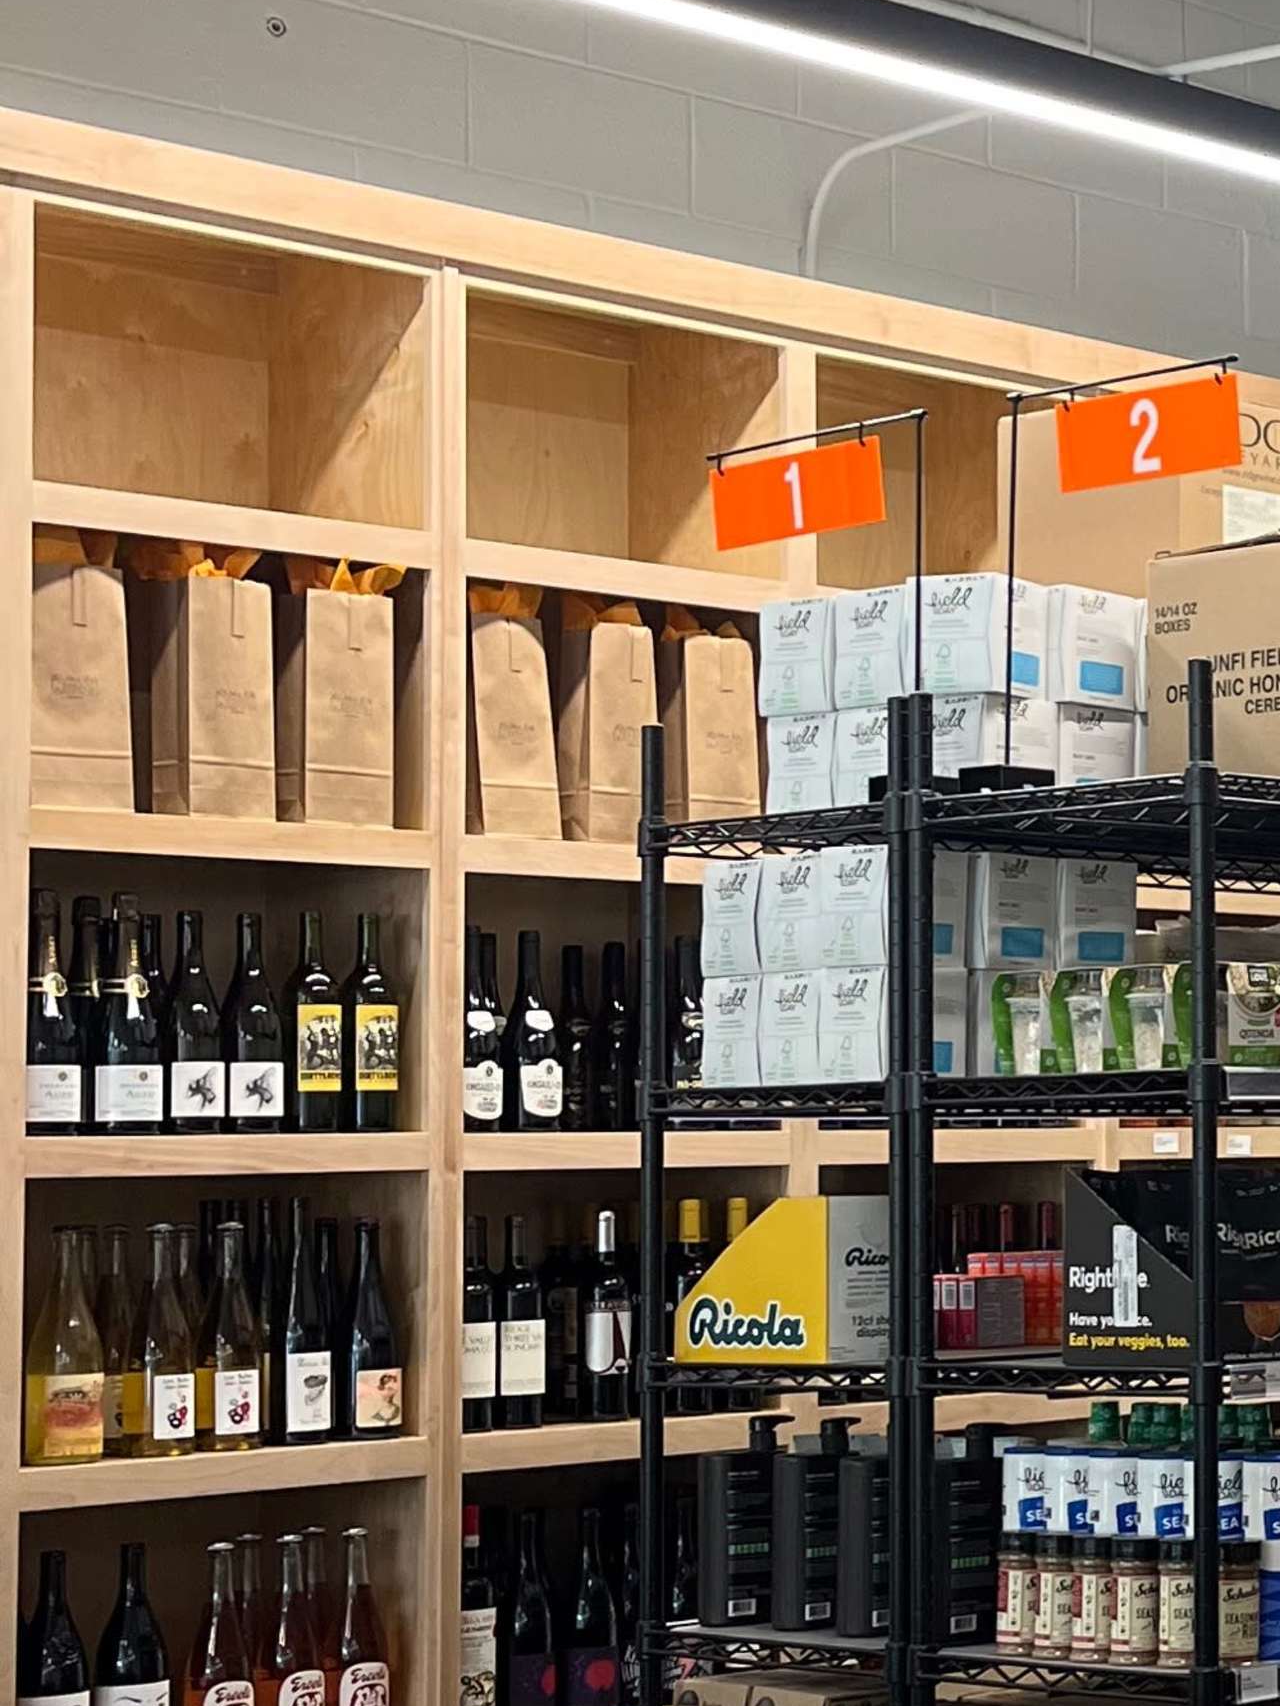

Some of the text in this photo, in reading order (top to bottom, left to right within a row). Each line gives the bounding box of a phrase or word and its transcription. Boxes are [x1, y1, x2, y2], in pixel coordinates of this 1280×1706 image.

[1129, 398, 1162, 474] 2
[783, 461, 804, 529] 1
[1180, 602, 1198, 616] OZ
[1154, 619, 1191, 635] BOXES
[1166, 677, 1243, 704] ORNIC
[845, 1247, 890, 1266] Rico
[689, 1295, 805, 1350] Ricola
[1069, 1313, 1114, 1329] Have yo
[1069, 1333, 1190, 1350] Eat your veggies, too.
